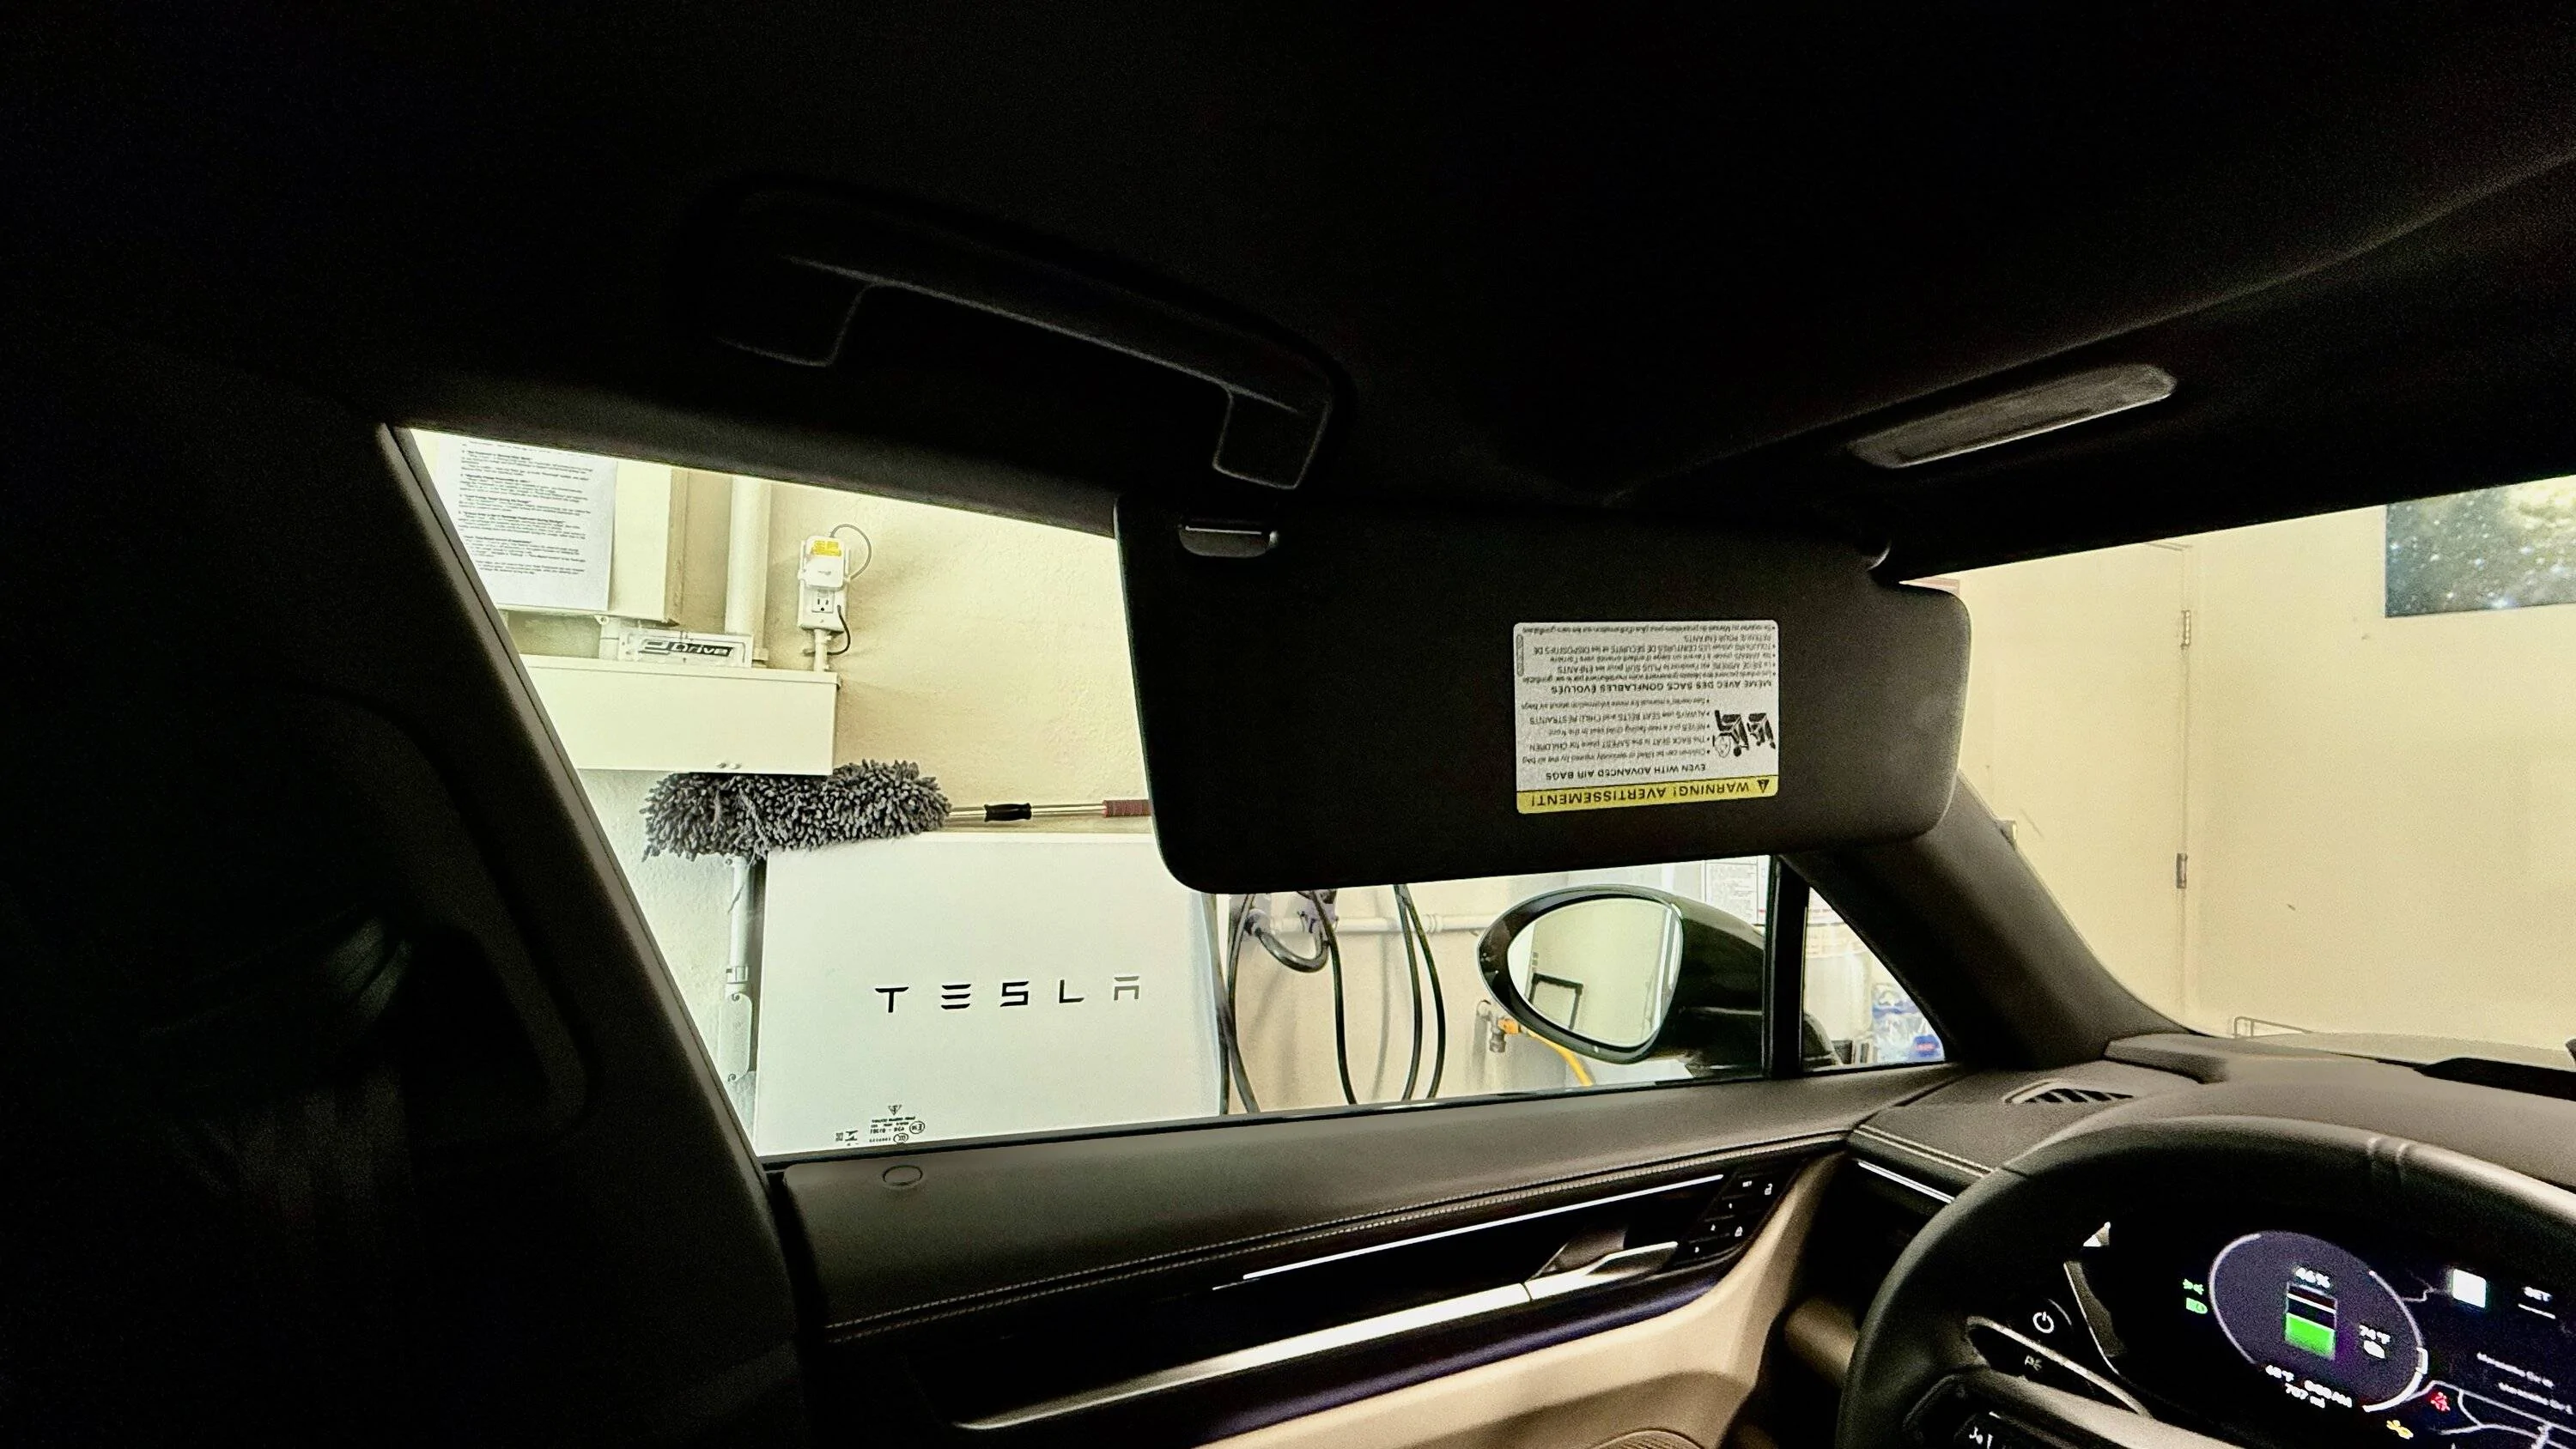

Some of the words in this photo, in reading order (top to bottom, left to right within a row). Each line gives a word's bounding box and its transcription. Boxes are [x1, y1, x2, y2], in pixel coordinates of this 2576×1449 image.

[1599, 682, 1663, 692] GONFLABLES
[1666, 681, 1692, 690] SACS
[1695, 681, 1714, 689] DES
[1716, 680, 1741, 688] AVEC
[1550, 684, 1596, 695] ÉVOLUÉS
[1528, 713, 1577, 724] RESTRAINTS
[1642, 711, 1660, 719] SEAT
[1675, 709, 1705, 718] ALWAYS
[1672, 736, 1692, 745] BACK
[1597, 766, 1651, 778] ADVANCED
[1654, 764, 1679, 774] WITH
[1680, 763, 1705, 773] EVEN
[1545, 770, 1574, 780] BAGS
[1577, 769, 1594, 779] AIR
[1672, 781, 1748, 797] WARNING!
[1530, 786, 1666, 807] AVERTISSEMENT!
[875, 975, 1140, 1013] TESLA
